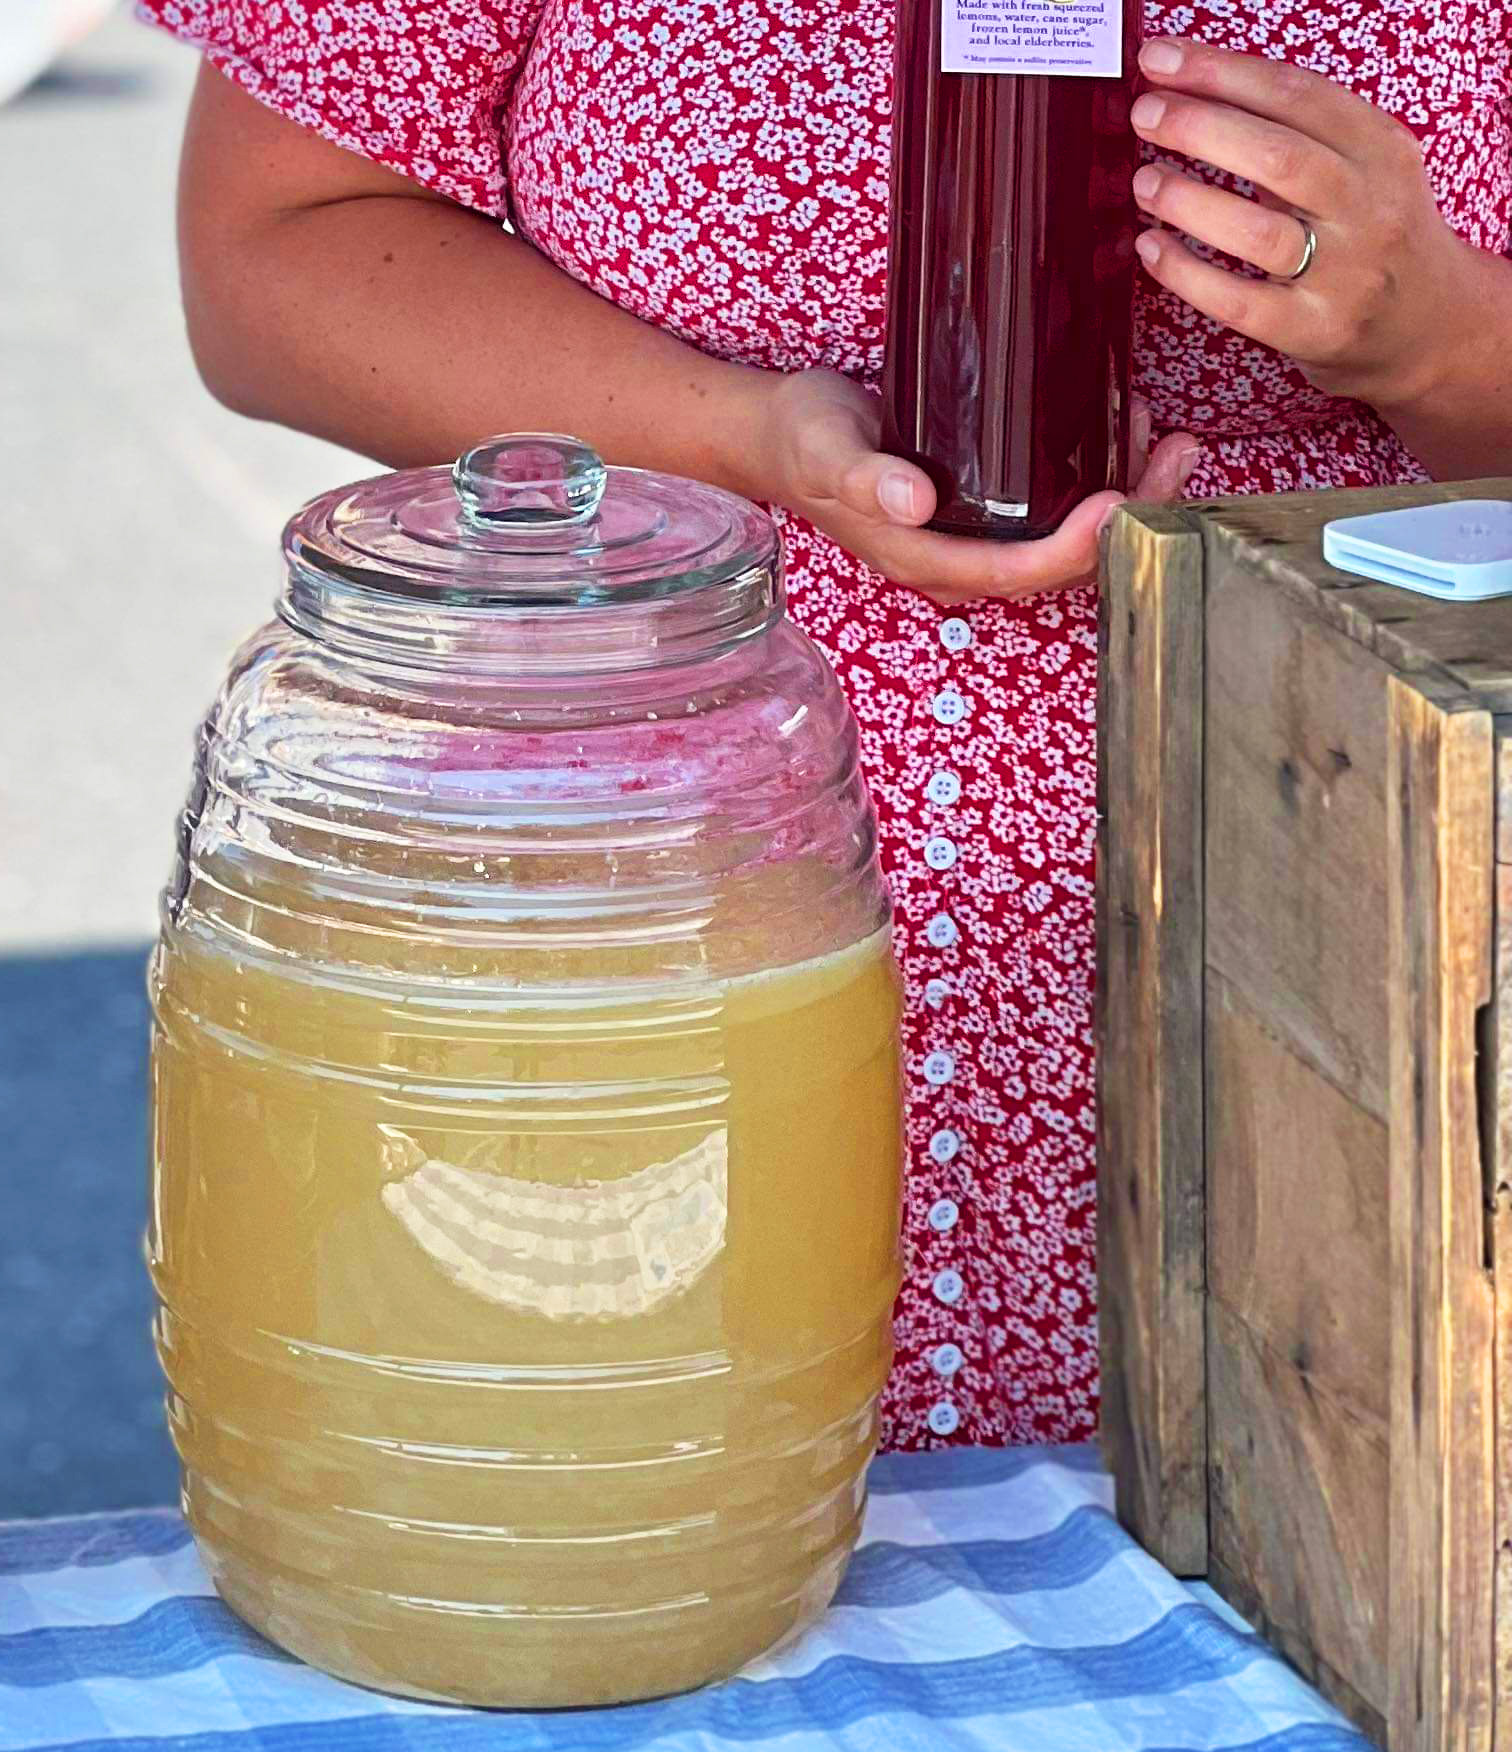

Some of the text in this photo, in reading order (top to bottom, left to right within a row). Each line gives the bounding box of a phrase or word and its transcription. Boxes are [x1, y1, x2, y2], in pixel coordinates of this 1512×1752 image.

[992, 0, 1018, 11] with
[1021, 0, 1050, 11] fresh
[1054, 2, 1104, 14] squeezed
[957, 10, 1107, 26] lemons, water, cane sugar,
[971, 23, 1009, 34] frozen
[1012, 23, 1048, 35] lemon
[969, 34, 1095, 48] and local elderberries.
